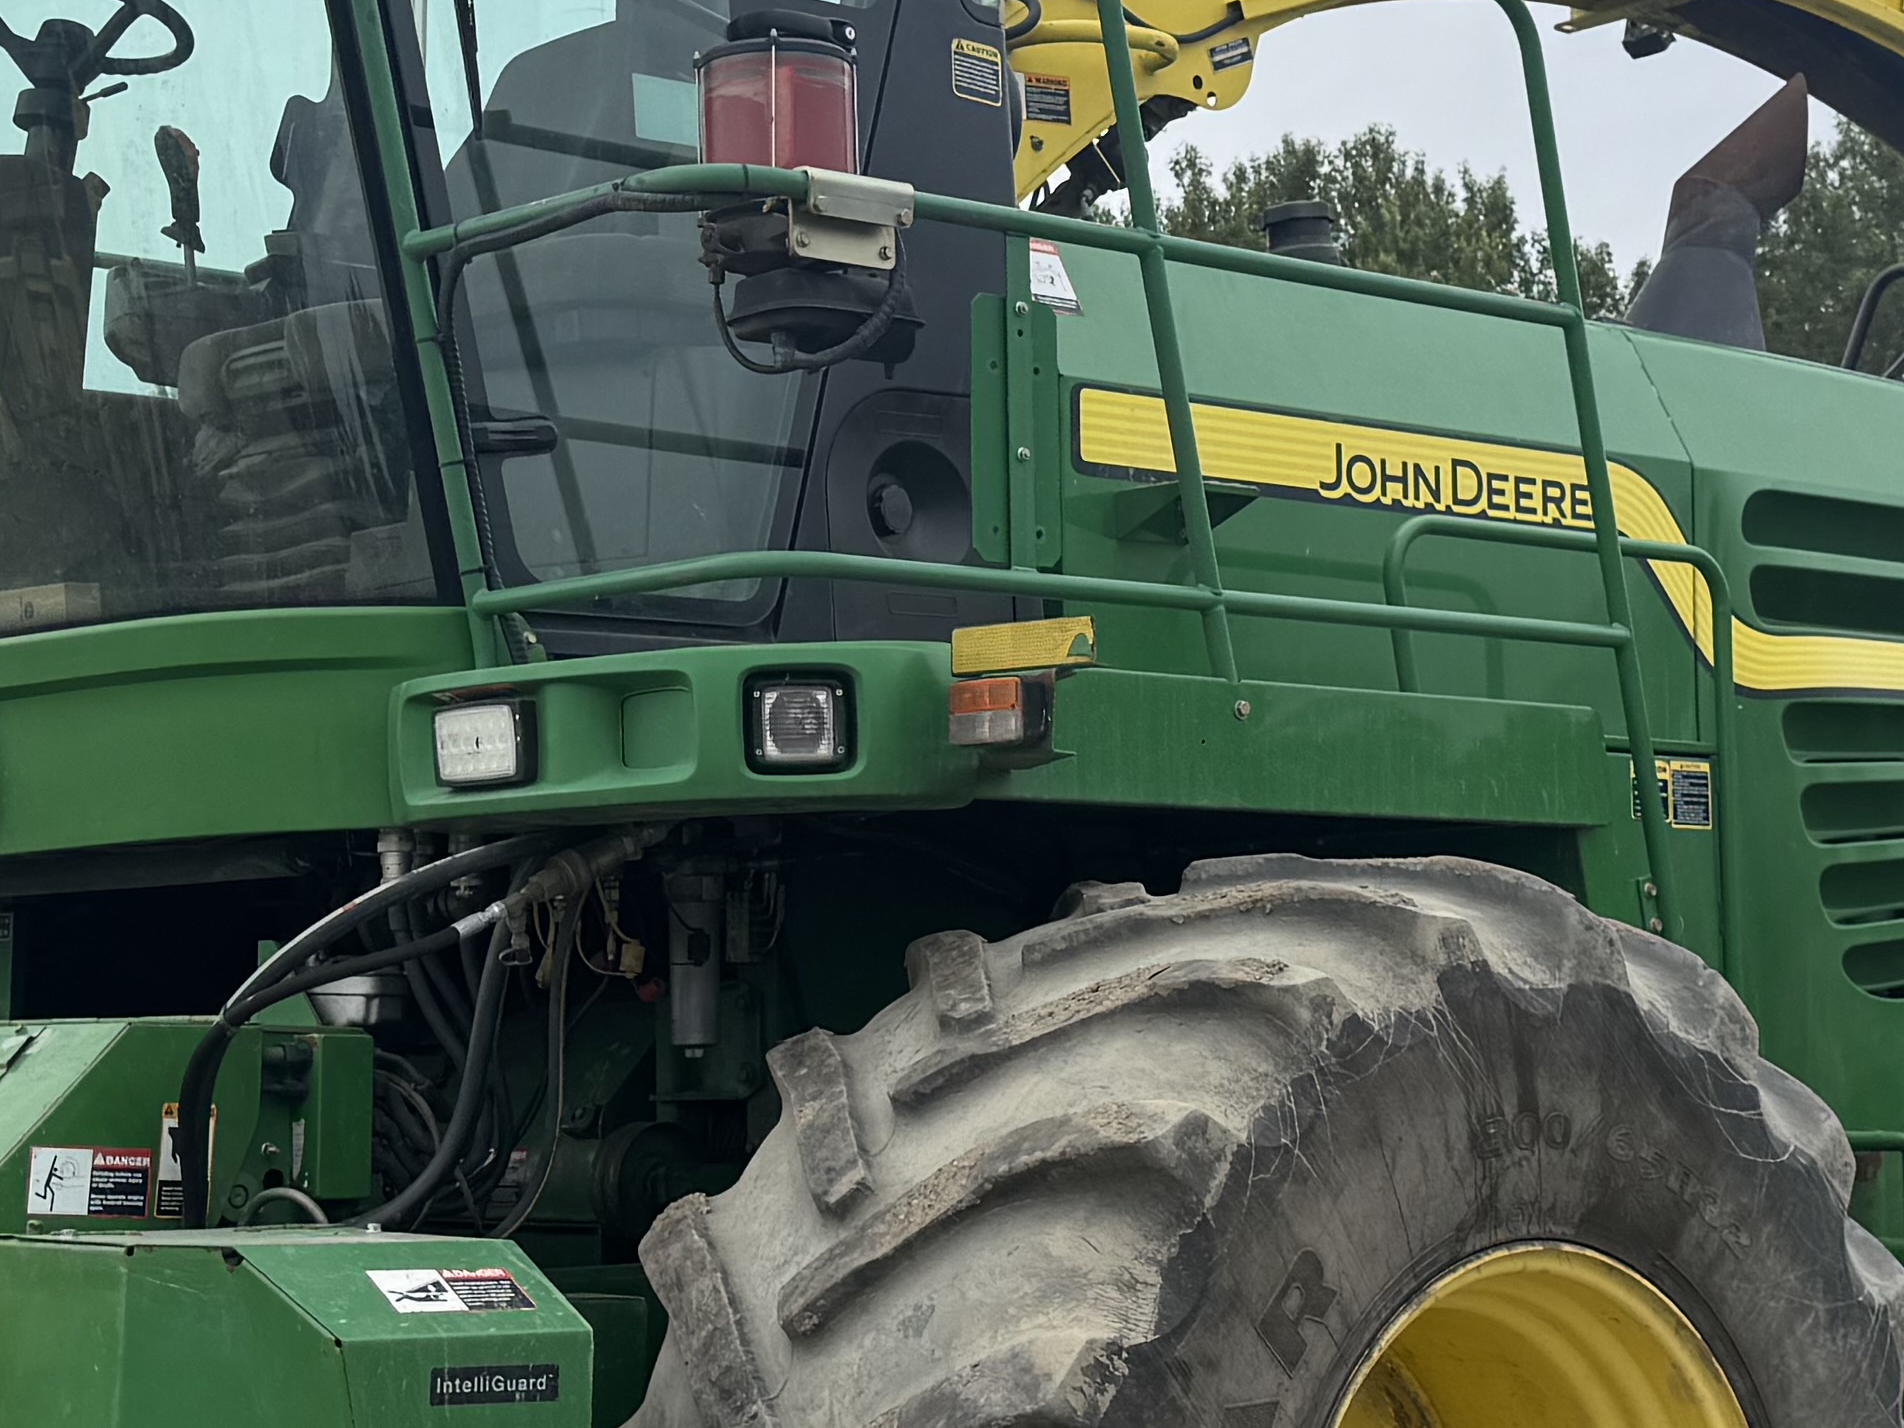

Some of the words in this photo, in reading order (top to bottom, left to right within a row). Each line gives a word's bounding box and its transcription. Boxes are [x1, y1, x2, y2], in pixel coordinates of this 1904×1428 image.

[1319, 442, 1441, 505] JOHN
[1451, 457, 1594, 522] DEERE
[105, 1155, 151, 1167] DANGER
[436, 1374, 548, 1394] IntelliGuard
